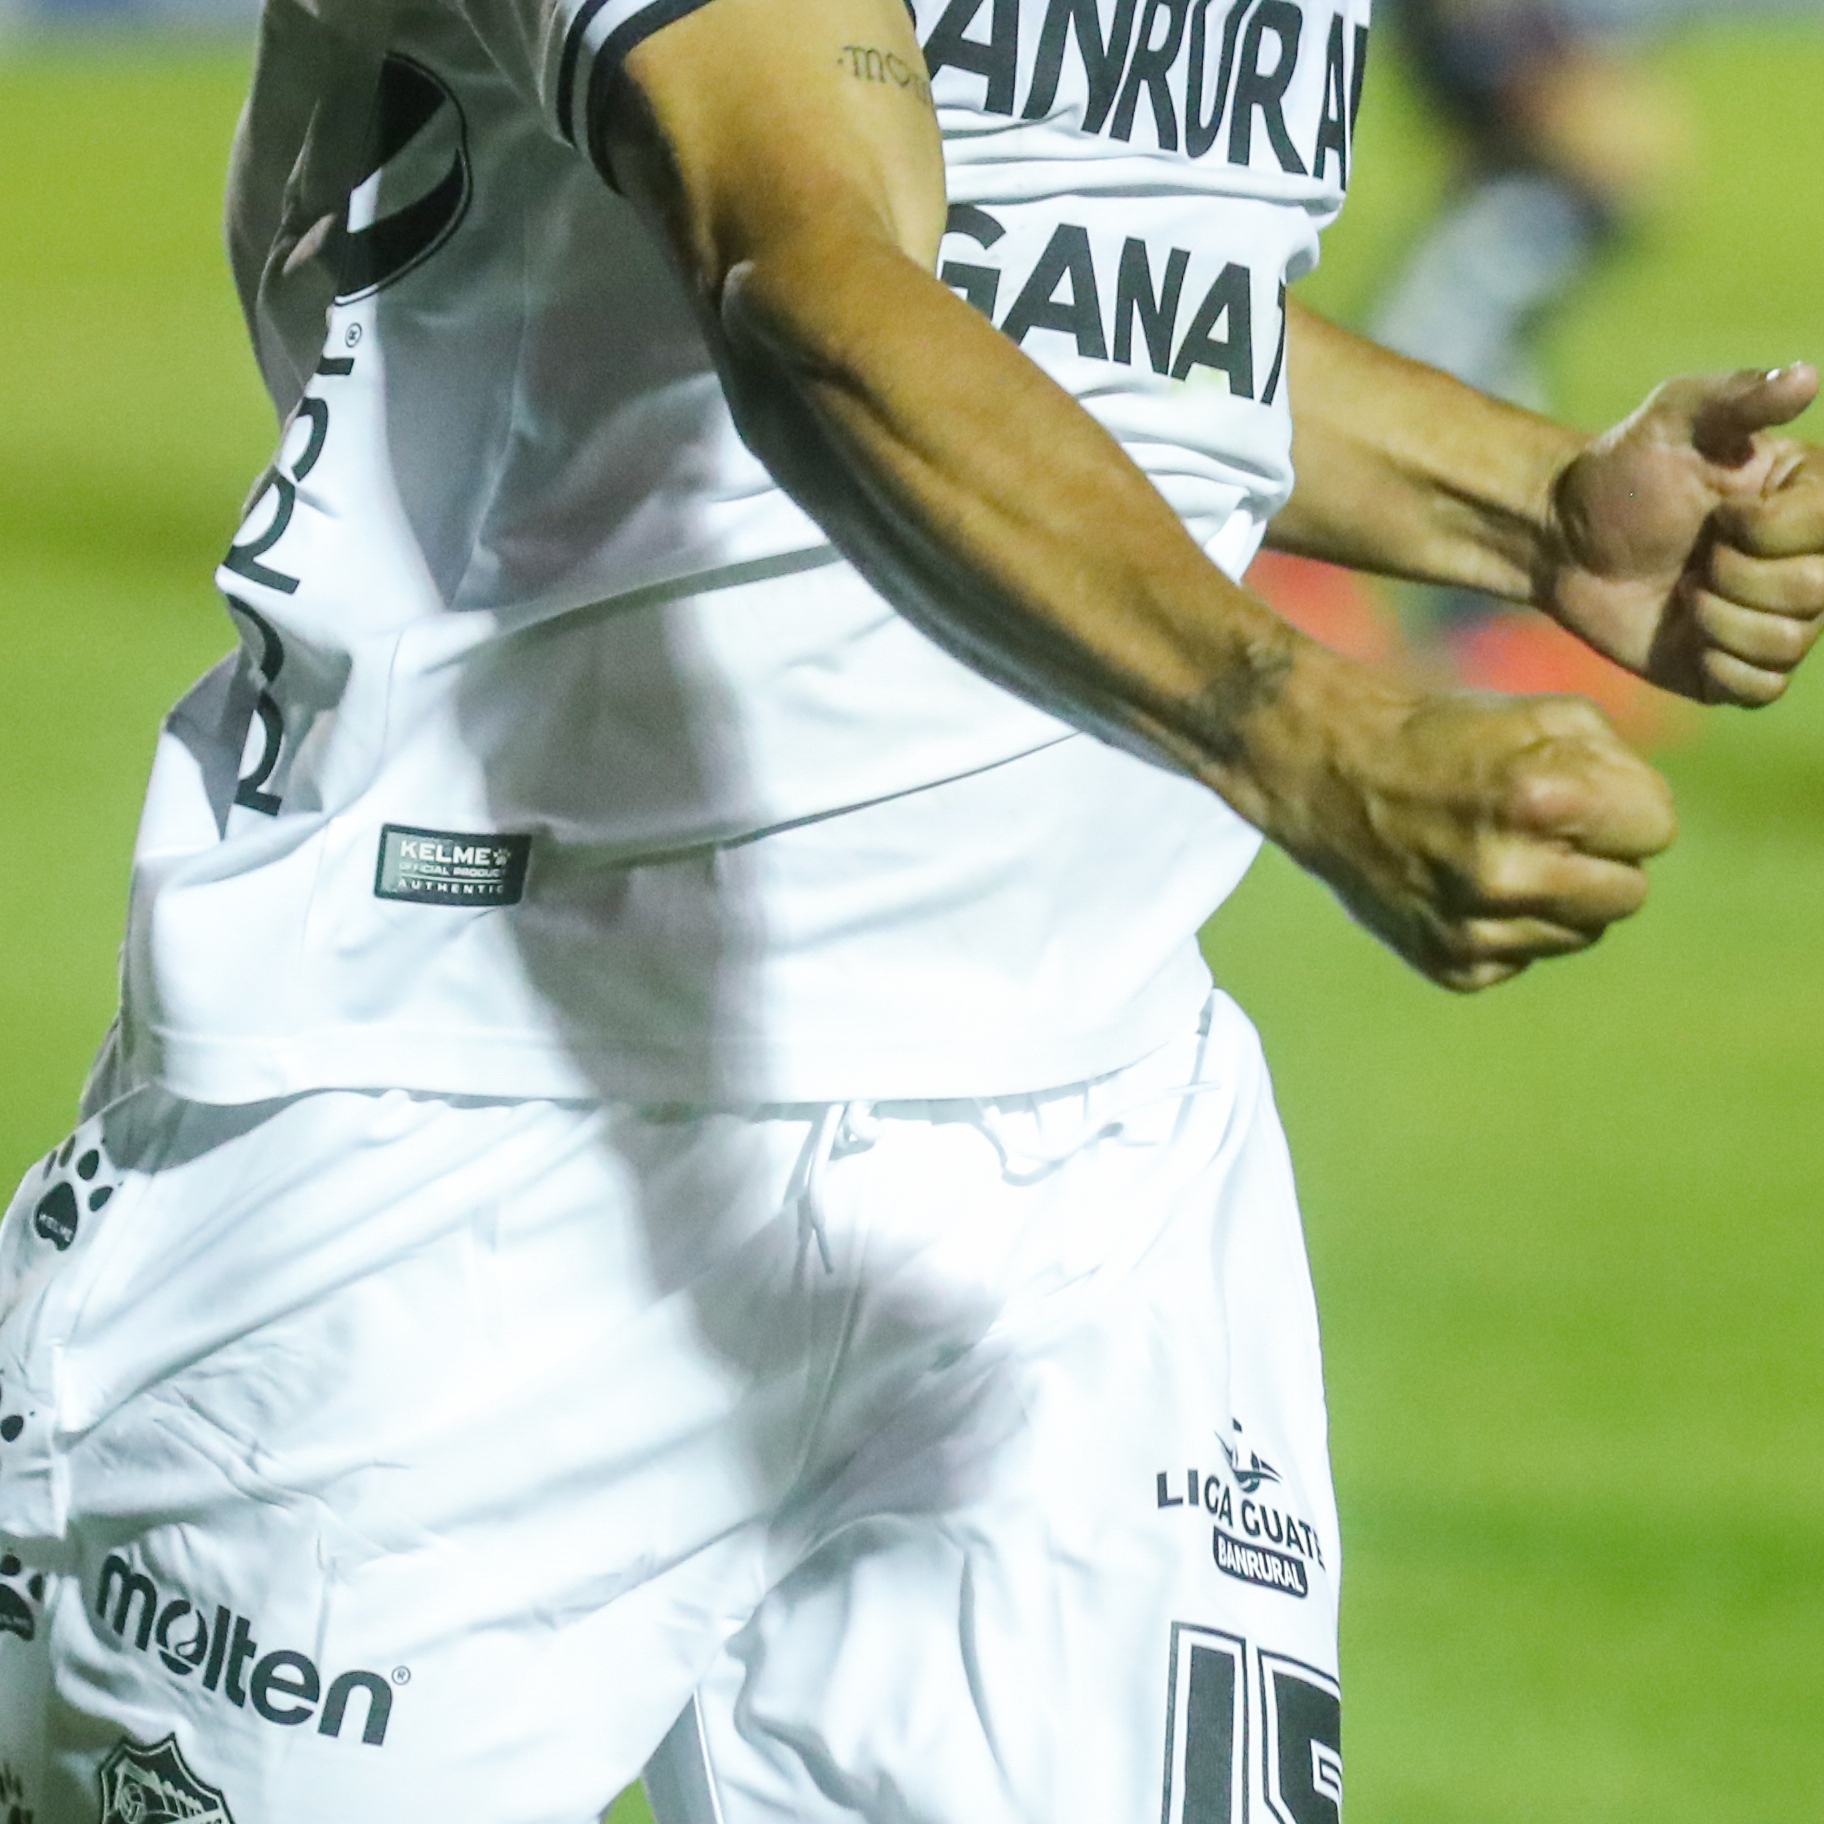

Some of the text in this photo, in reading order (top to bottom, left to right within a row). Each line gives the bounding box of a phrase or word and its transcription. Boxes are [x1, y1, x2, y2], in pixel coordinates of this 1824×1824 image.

[938, 204, 1286, 405] GANA
[399, 839, 492, 865] KELME
[396, 878, 505, 895] AUTHENTIC
[1156, 1468, 1234, 1527] LIGA
[1217, 1534, 1305, 1594] BANRURAL
[96, 1553, 394, 1747] molten
